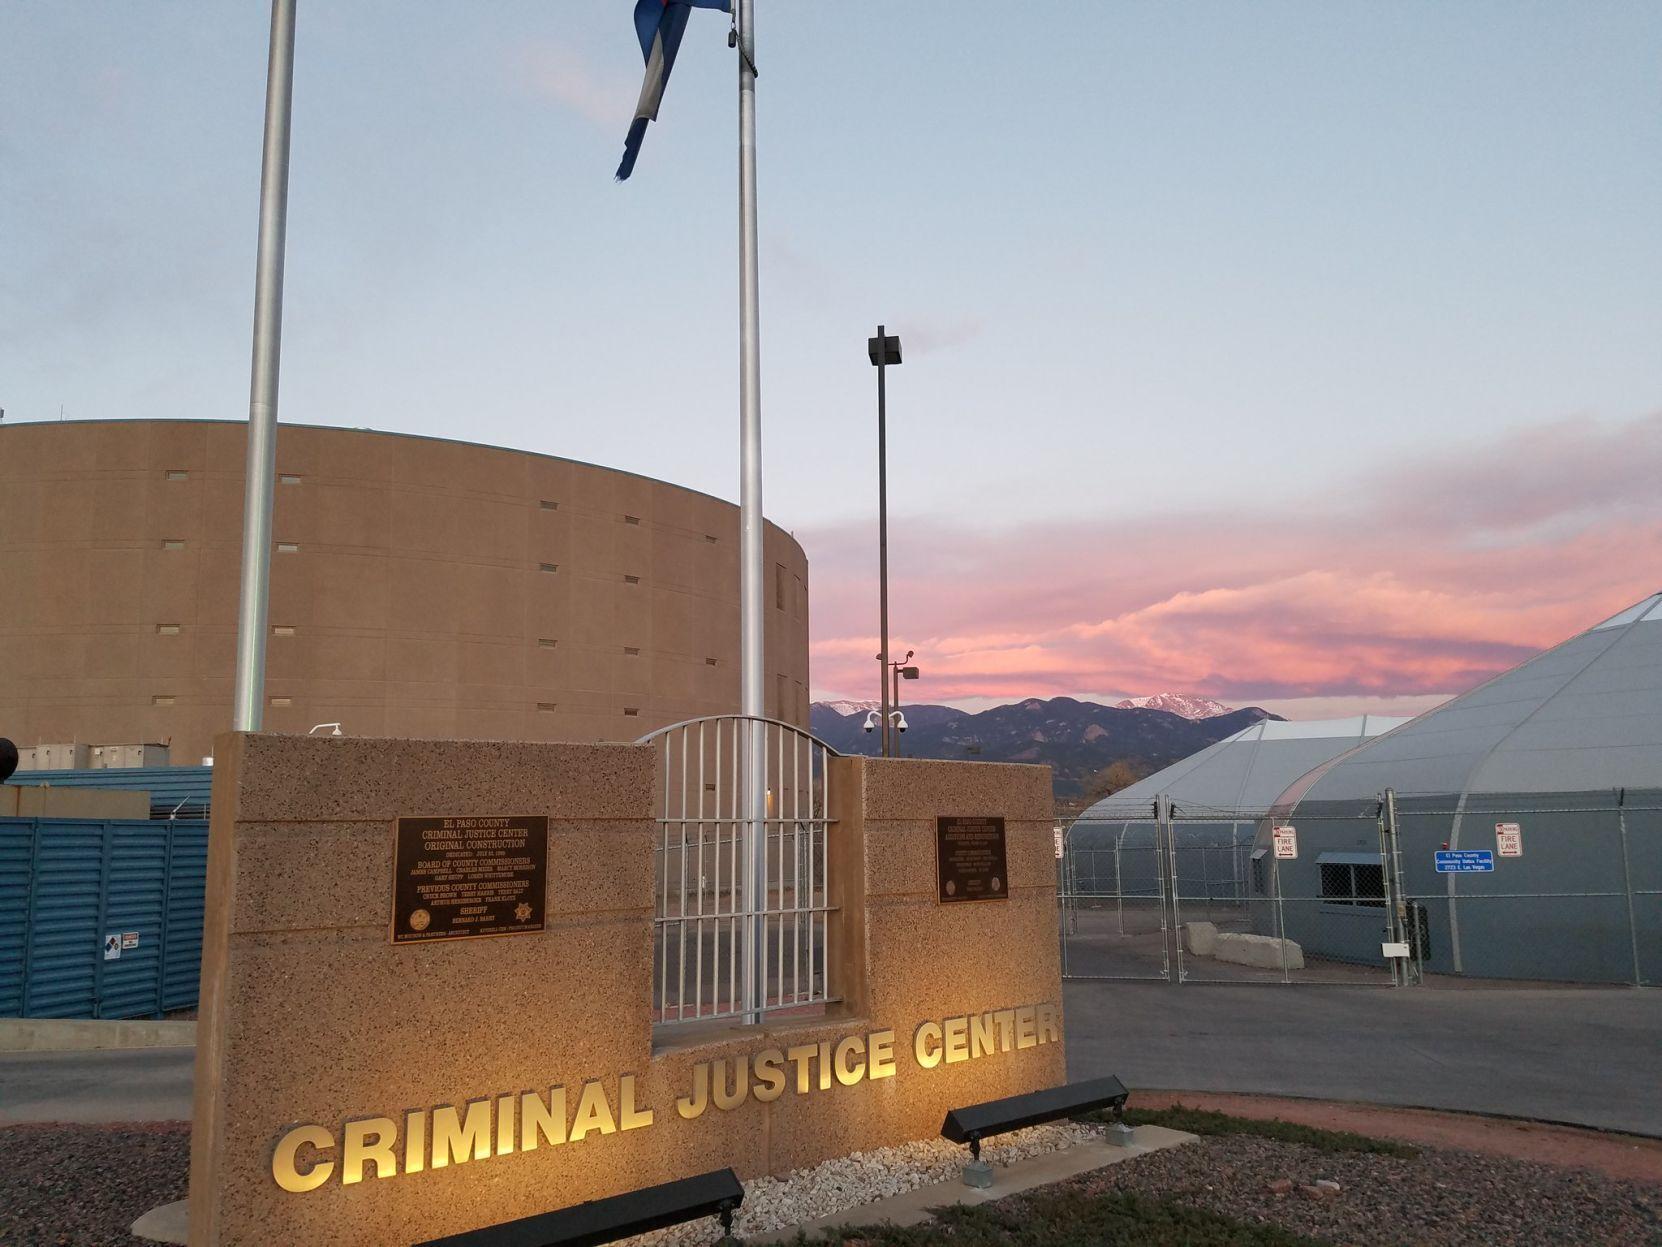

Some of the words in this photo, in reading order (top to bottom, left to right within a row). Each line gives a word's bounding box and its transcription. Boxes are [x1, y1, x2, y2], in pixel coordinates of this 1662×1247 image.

[443, 819, 455, 828] EL
[457, 819, 477, 828] PASO
[478, 818, 511, 828] COUNTY
[422, 830, 463, 840] CRIMINAL
[464, 829, 496, 839] JUSTICE
[498, 828, 529, 838] CENTER
[424, 840, 464, 850] ORIGINAL
[466, 839, 526, 849] CONSTRUCTION
[417, 860, 441, 869] BOARD
[441, 859, 451, 868] OF
[452, 859, 479, 867] COUNTY
[479, 857, 531, 866] COMMISSIONERS
[416, 884, 449, 893] PREVIOUS
[450, 882, 478, 892] COUNTY
[478, 880, 530, 890] COMMISSIONERS
[460, 906, 488, 915] SHERIFF
[272, 1075, 654, 1193] CRIMINAL
[677, 1030, 896, 1120] JUSTICE
[914, 1003, 1062, 1069] CENTER
